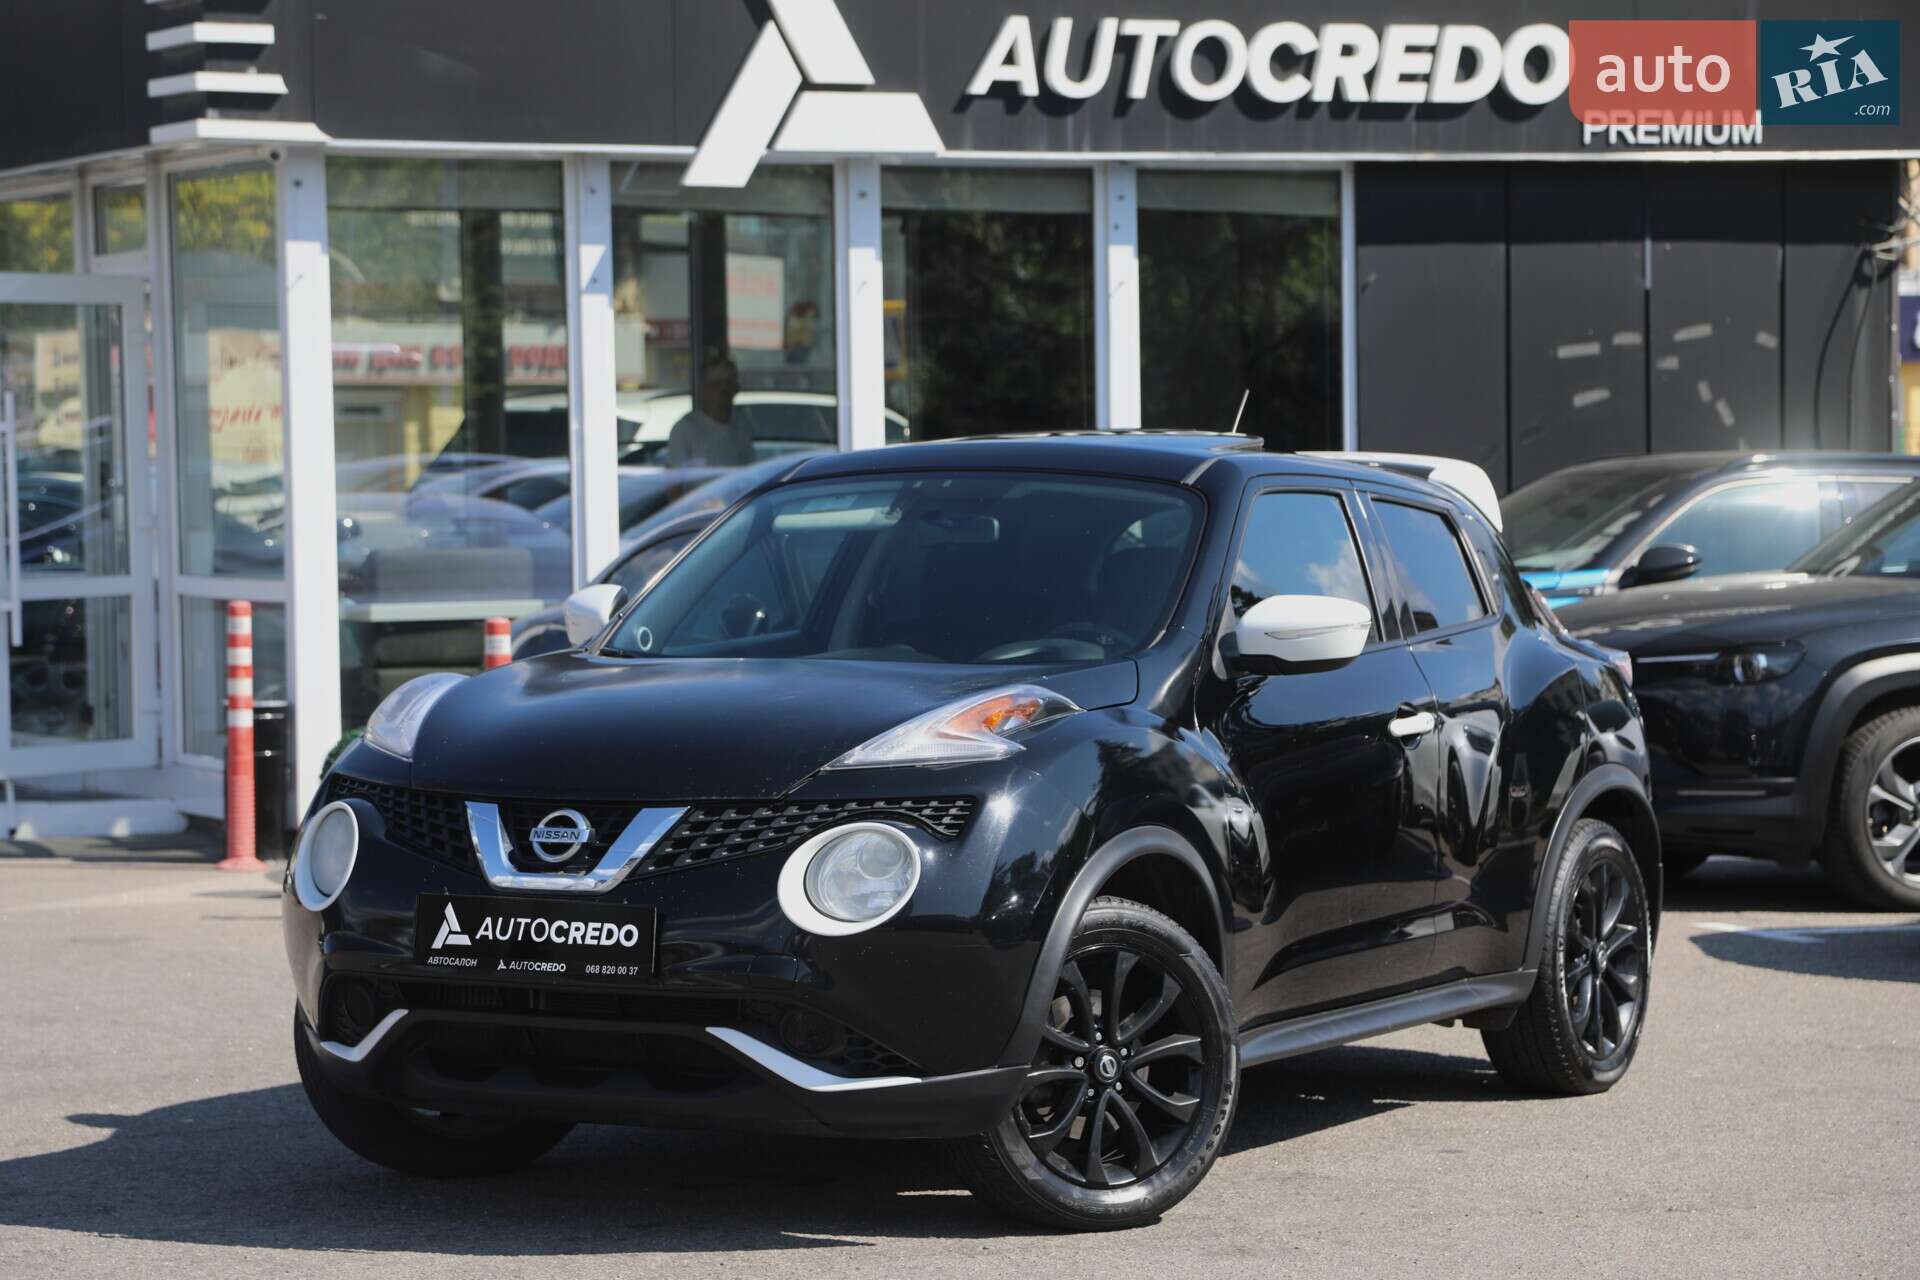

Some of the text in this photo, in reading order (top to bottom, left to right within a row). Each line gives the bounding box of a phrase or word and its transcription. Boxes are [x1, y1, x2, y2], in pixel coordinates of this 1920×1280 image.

[966, 15, 1575, 105] AUTOCREDO
[1582, 109, 1763, 145] PREMIUM
[533, 829, 581, 841] NISSAN
[475, 916, 639, 947] AUTOCREDO
[427, 955, 478, 967] АВТОСАЛОН
[509, 960, 567, 972] AUTOCREDO
[585, 964, 639, 976] 068 820 00 37
